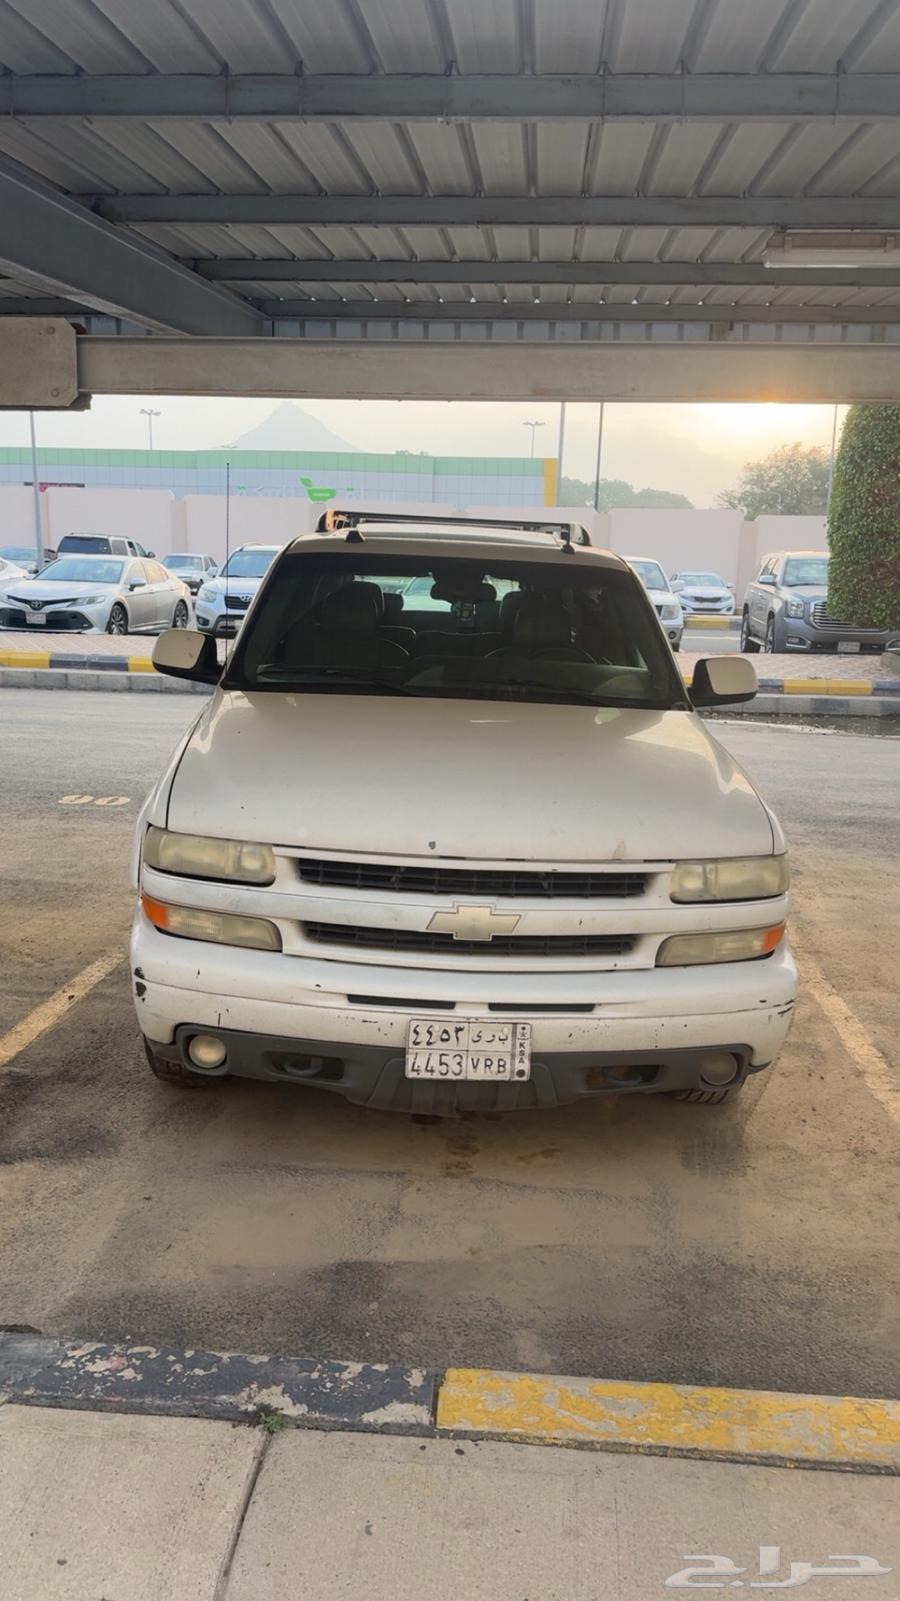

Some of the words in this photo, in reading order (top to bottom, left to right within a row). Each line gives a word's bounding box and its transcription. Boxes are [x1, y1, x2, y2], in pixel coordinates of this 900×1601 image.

[412, 1024, 465, 1046] ٤٤٥٣
[518, 1041, 526, 1064] KSA
[410, 1052, 463, 1077] 4453
[471, 1057, 507, 1074] VRB
